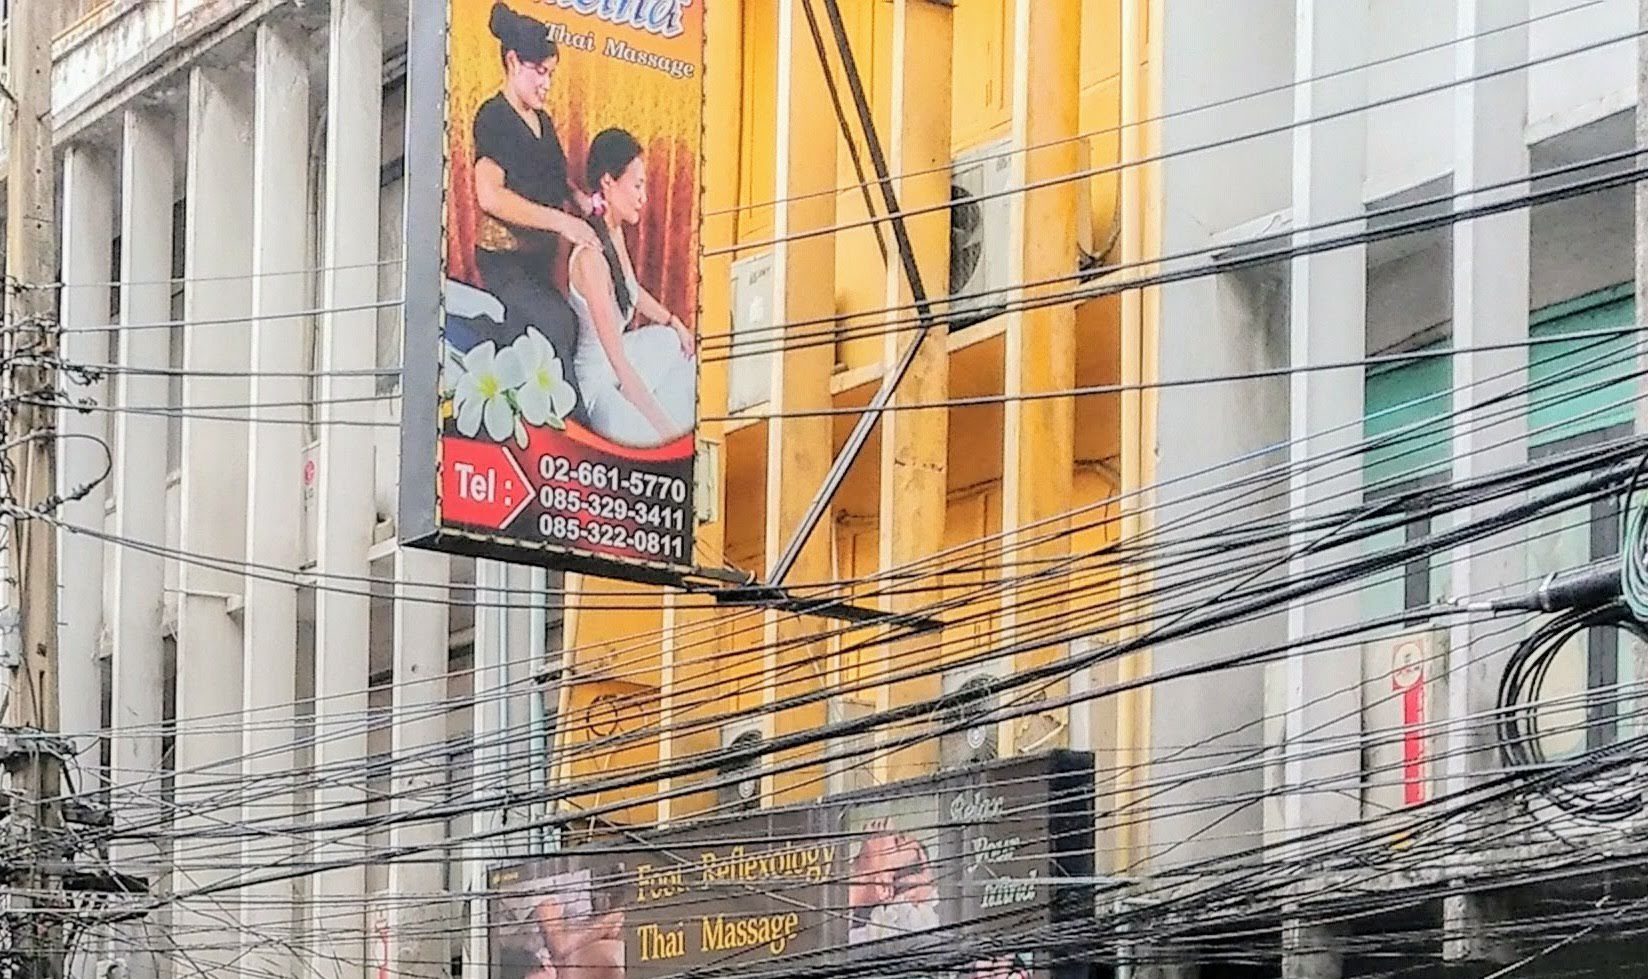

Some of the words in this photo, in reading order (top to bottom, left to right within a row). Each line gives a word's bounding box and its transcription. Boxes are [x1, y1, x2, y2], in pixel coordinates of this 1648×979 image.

[545, 22, 595, 51] Thai
[603, 37, 695, 79] Massage
[539, 454, 687, 503] 02-661-5770
[539, 485, 684, 531] 085-329-3411
[539, 514, 683, 558] 085-322-0811
[638, 922, 685, 962] Thai
[702, 911, 799, 955] Massage
